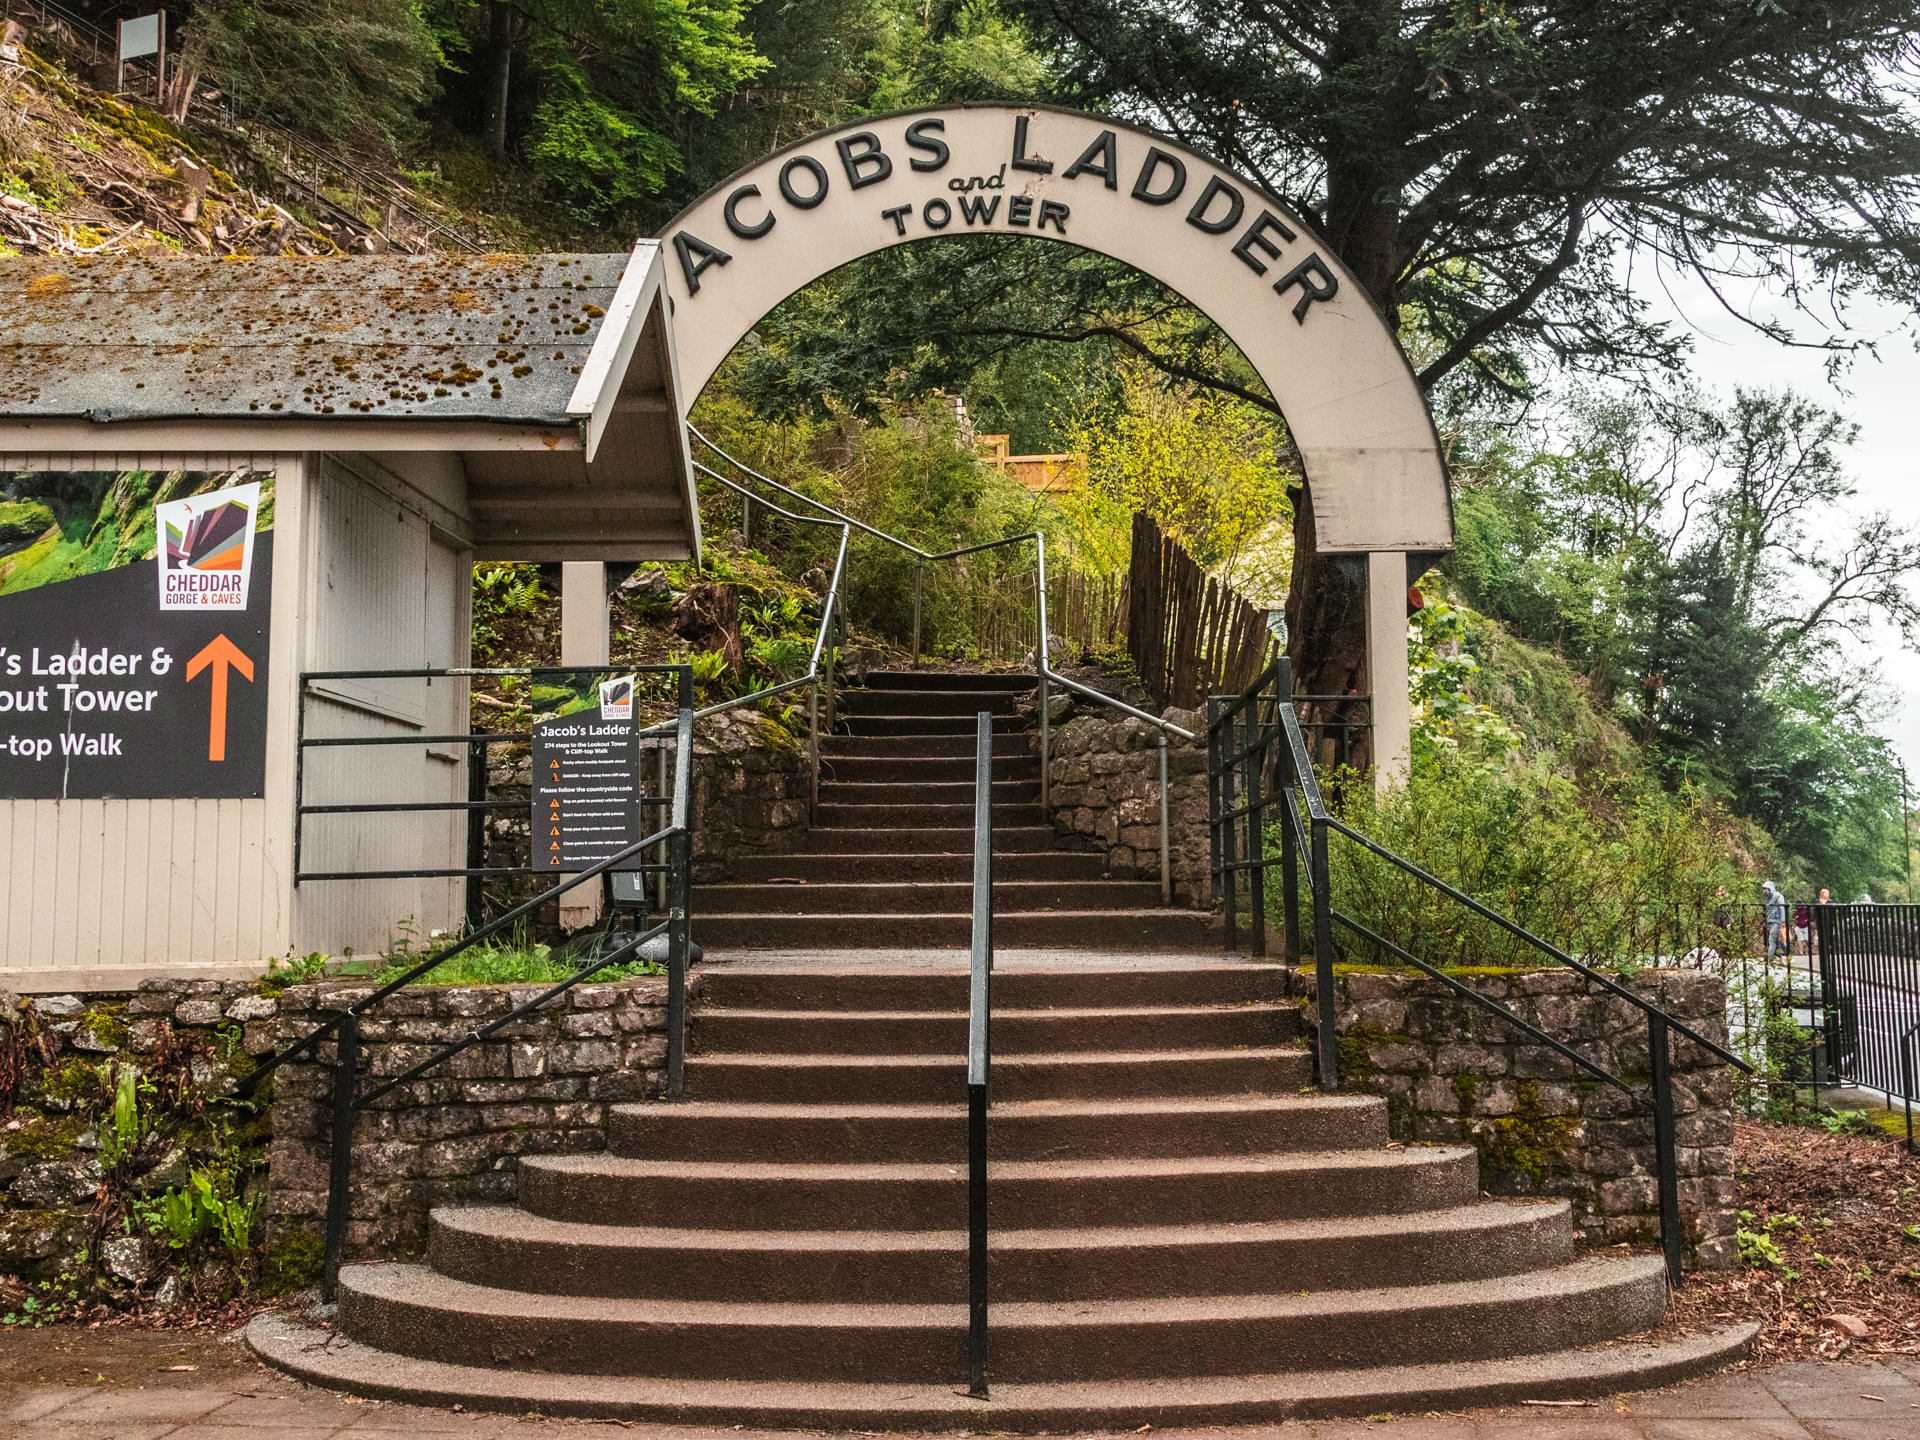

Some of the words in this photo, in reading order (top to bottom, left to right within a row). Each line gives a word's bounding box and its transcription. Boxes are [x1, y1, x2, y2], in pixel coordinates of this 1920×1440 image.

[948, 163, 1007, 194] and
[669, 117, 950, 317] ACOBS
[1011, 115, 1339, 327] LADDER
[881, 195, 1071, 237] TOWER
[166, 574, 242, 592] CHEDDAR
[166, 593, 199, 605] GORGE
[200, 593, 209, 605] &
[211, 593, 242, 605] CAVES
[31, 647, 143, 676] Ladder
[150, 647, 173, 676] &
[56, 683, 159, 712] Tower
[540, 725, 587, 737] Jacob's
[589, 724, 631, 736] Ladder
[59, 733, 122, 756] Walk
[586, 785, 619, 793] countryside
